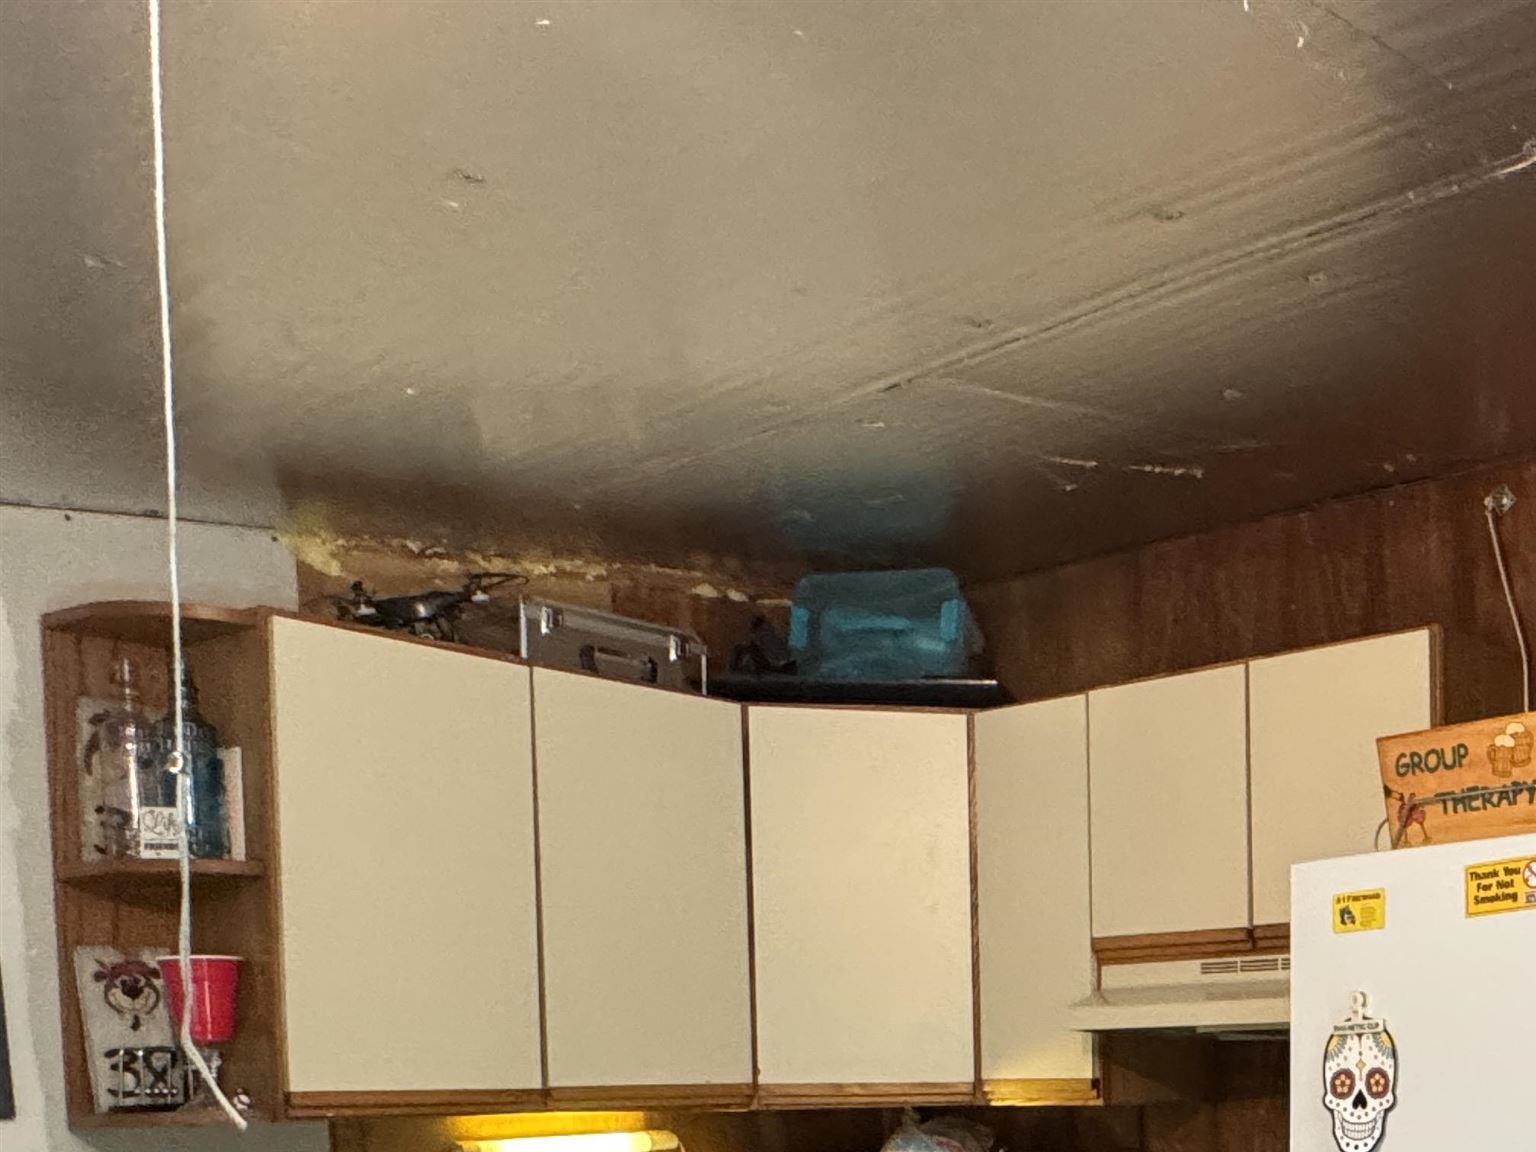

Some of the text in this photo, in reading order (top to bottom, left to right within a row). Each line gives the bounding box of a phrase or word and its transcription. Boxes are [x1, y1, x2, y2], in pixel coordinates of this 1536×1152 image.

[1395, 743, 1469, 778] GROUP
[1470, 866, 1521, 881] Thank You
[1477, 879, 1514, 892] For Not
[1474, 892, 1518, 905] Smoking
